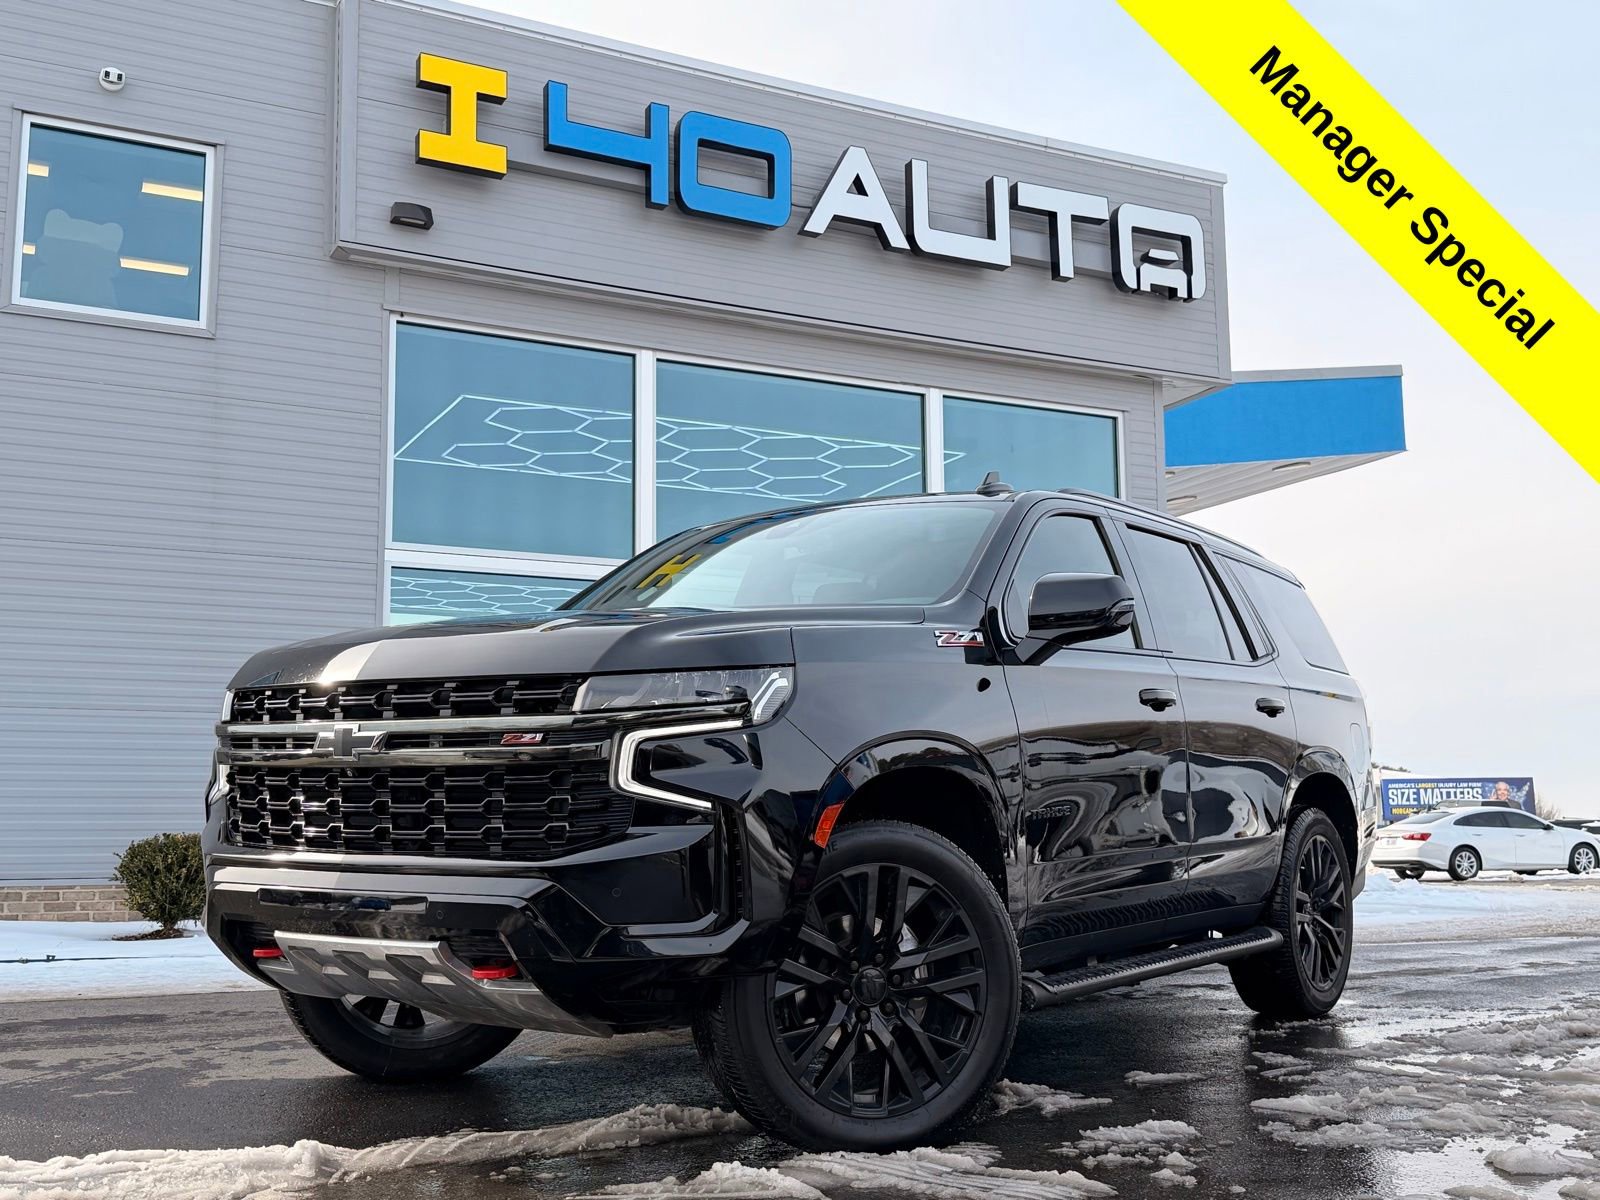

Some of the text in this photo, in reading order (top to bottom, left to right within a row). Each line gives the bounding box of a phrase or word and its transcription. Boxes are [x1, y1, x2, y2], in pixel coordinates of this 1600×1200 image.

[934, 630, 984, 647] Z71
[500, 733, 543, 744] Z71
[1388, 788, 1482, 804] SIZE MATTERS
